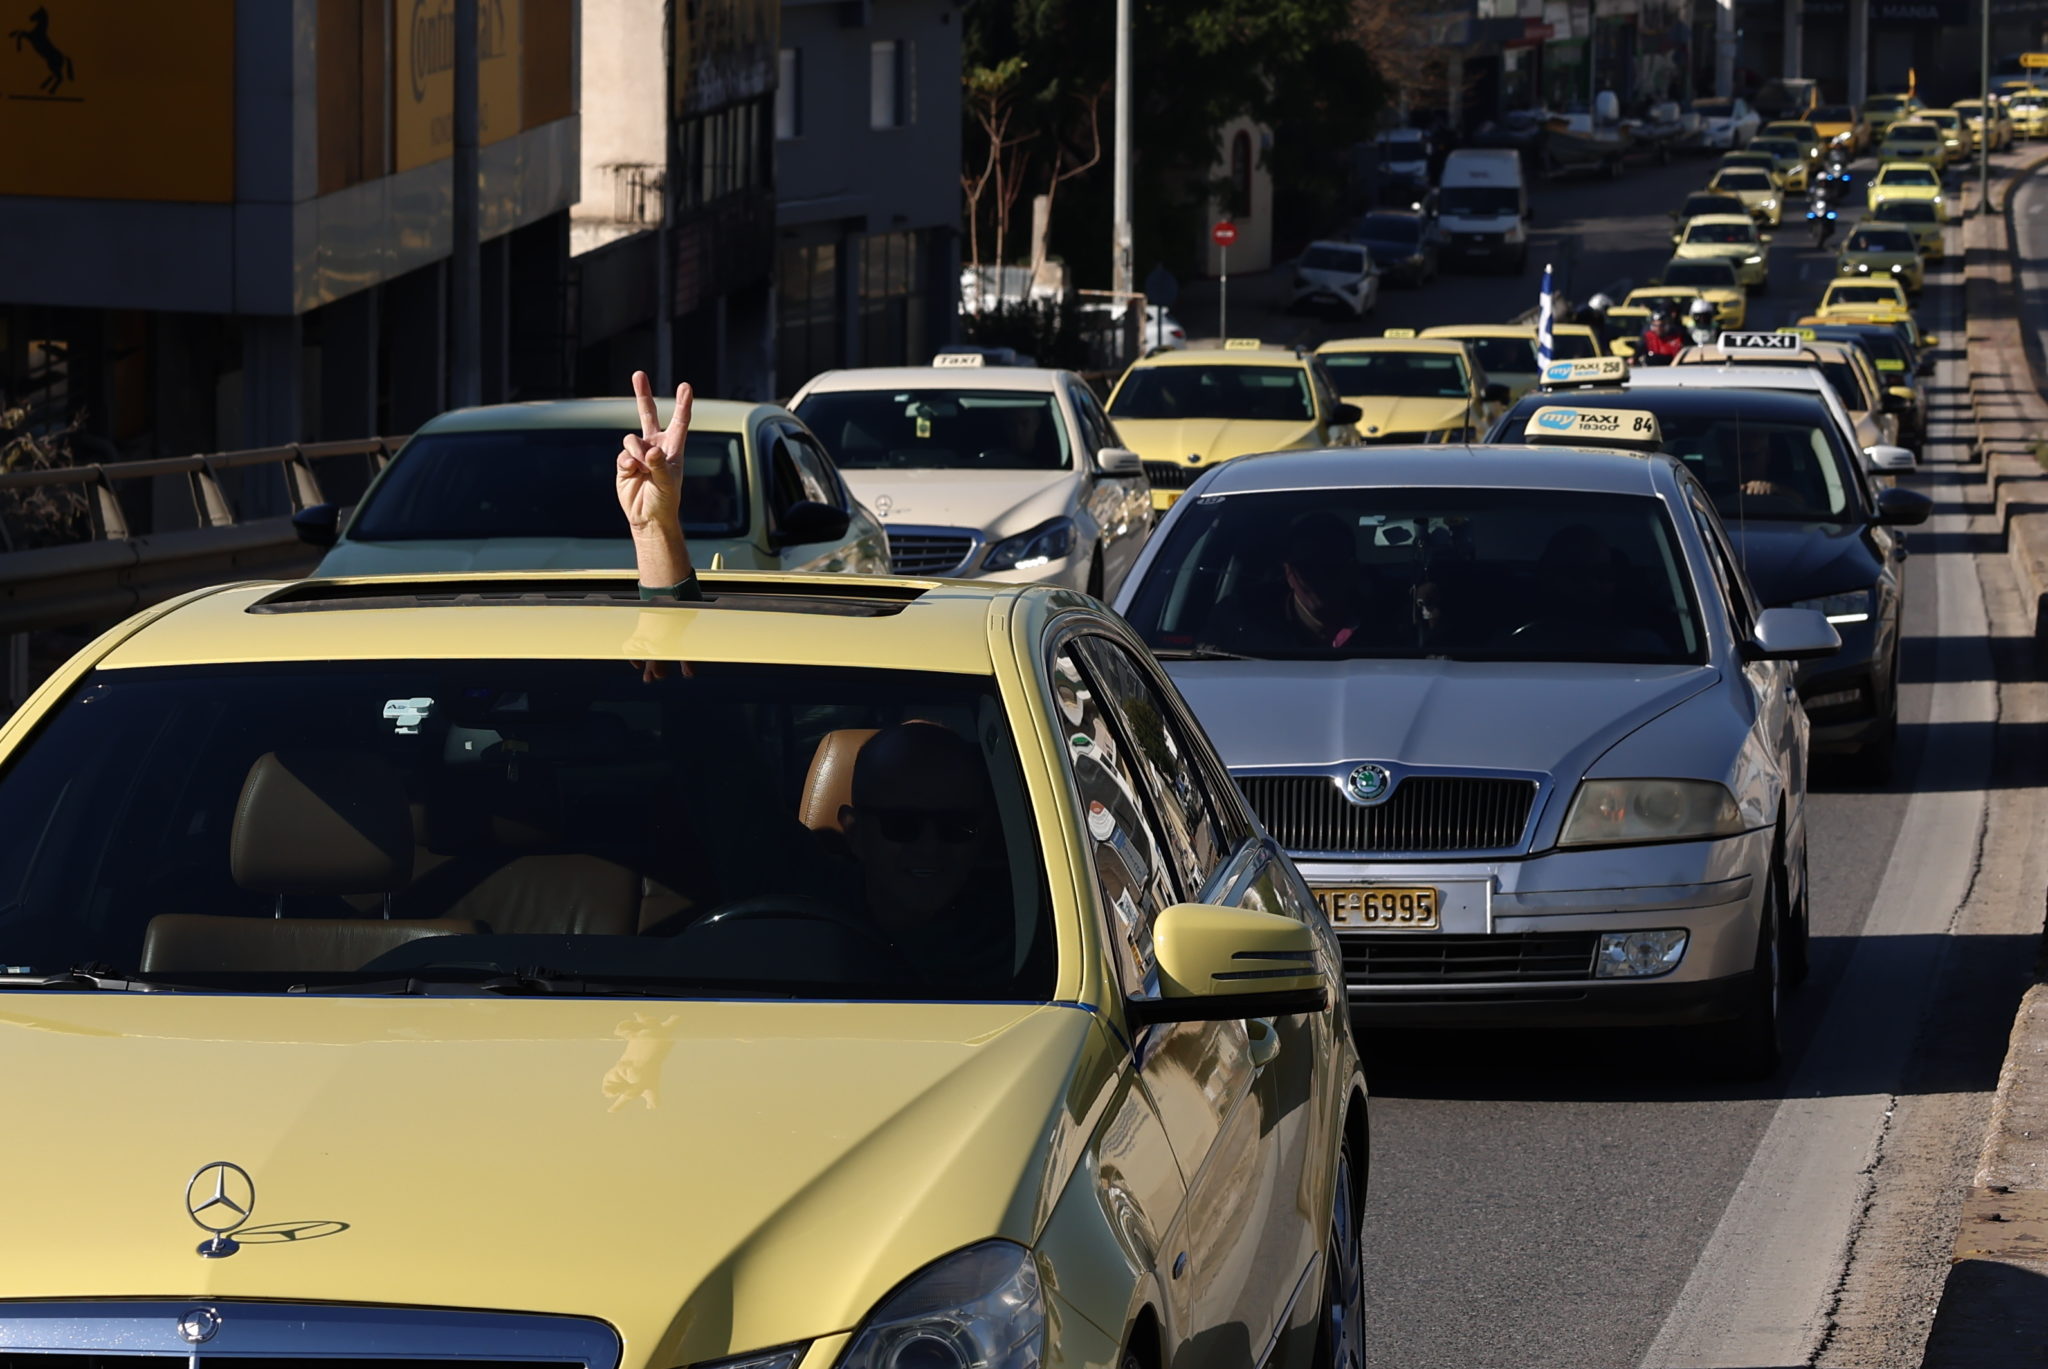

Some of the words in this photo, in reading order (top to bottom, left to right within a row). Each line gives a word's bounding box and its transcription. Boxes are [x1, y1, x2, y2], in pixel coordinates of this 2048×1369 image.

[1730, 336, 1790, 347] TAXI
[1577, 414, 1619, 423] TAXI
[1633, 417, 1653, 432] 84
[1318, 892, 1433, 922] AE-6995
